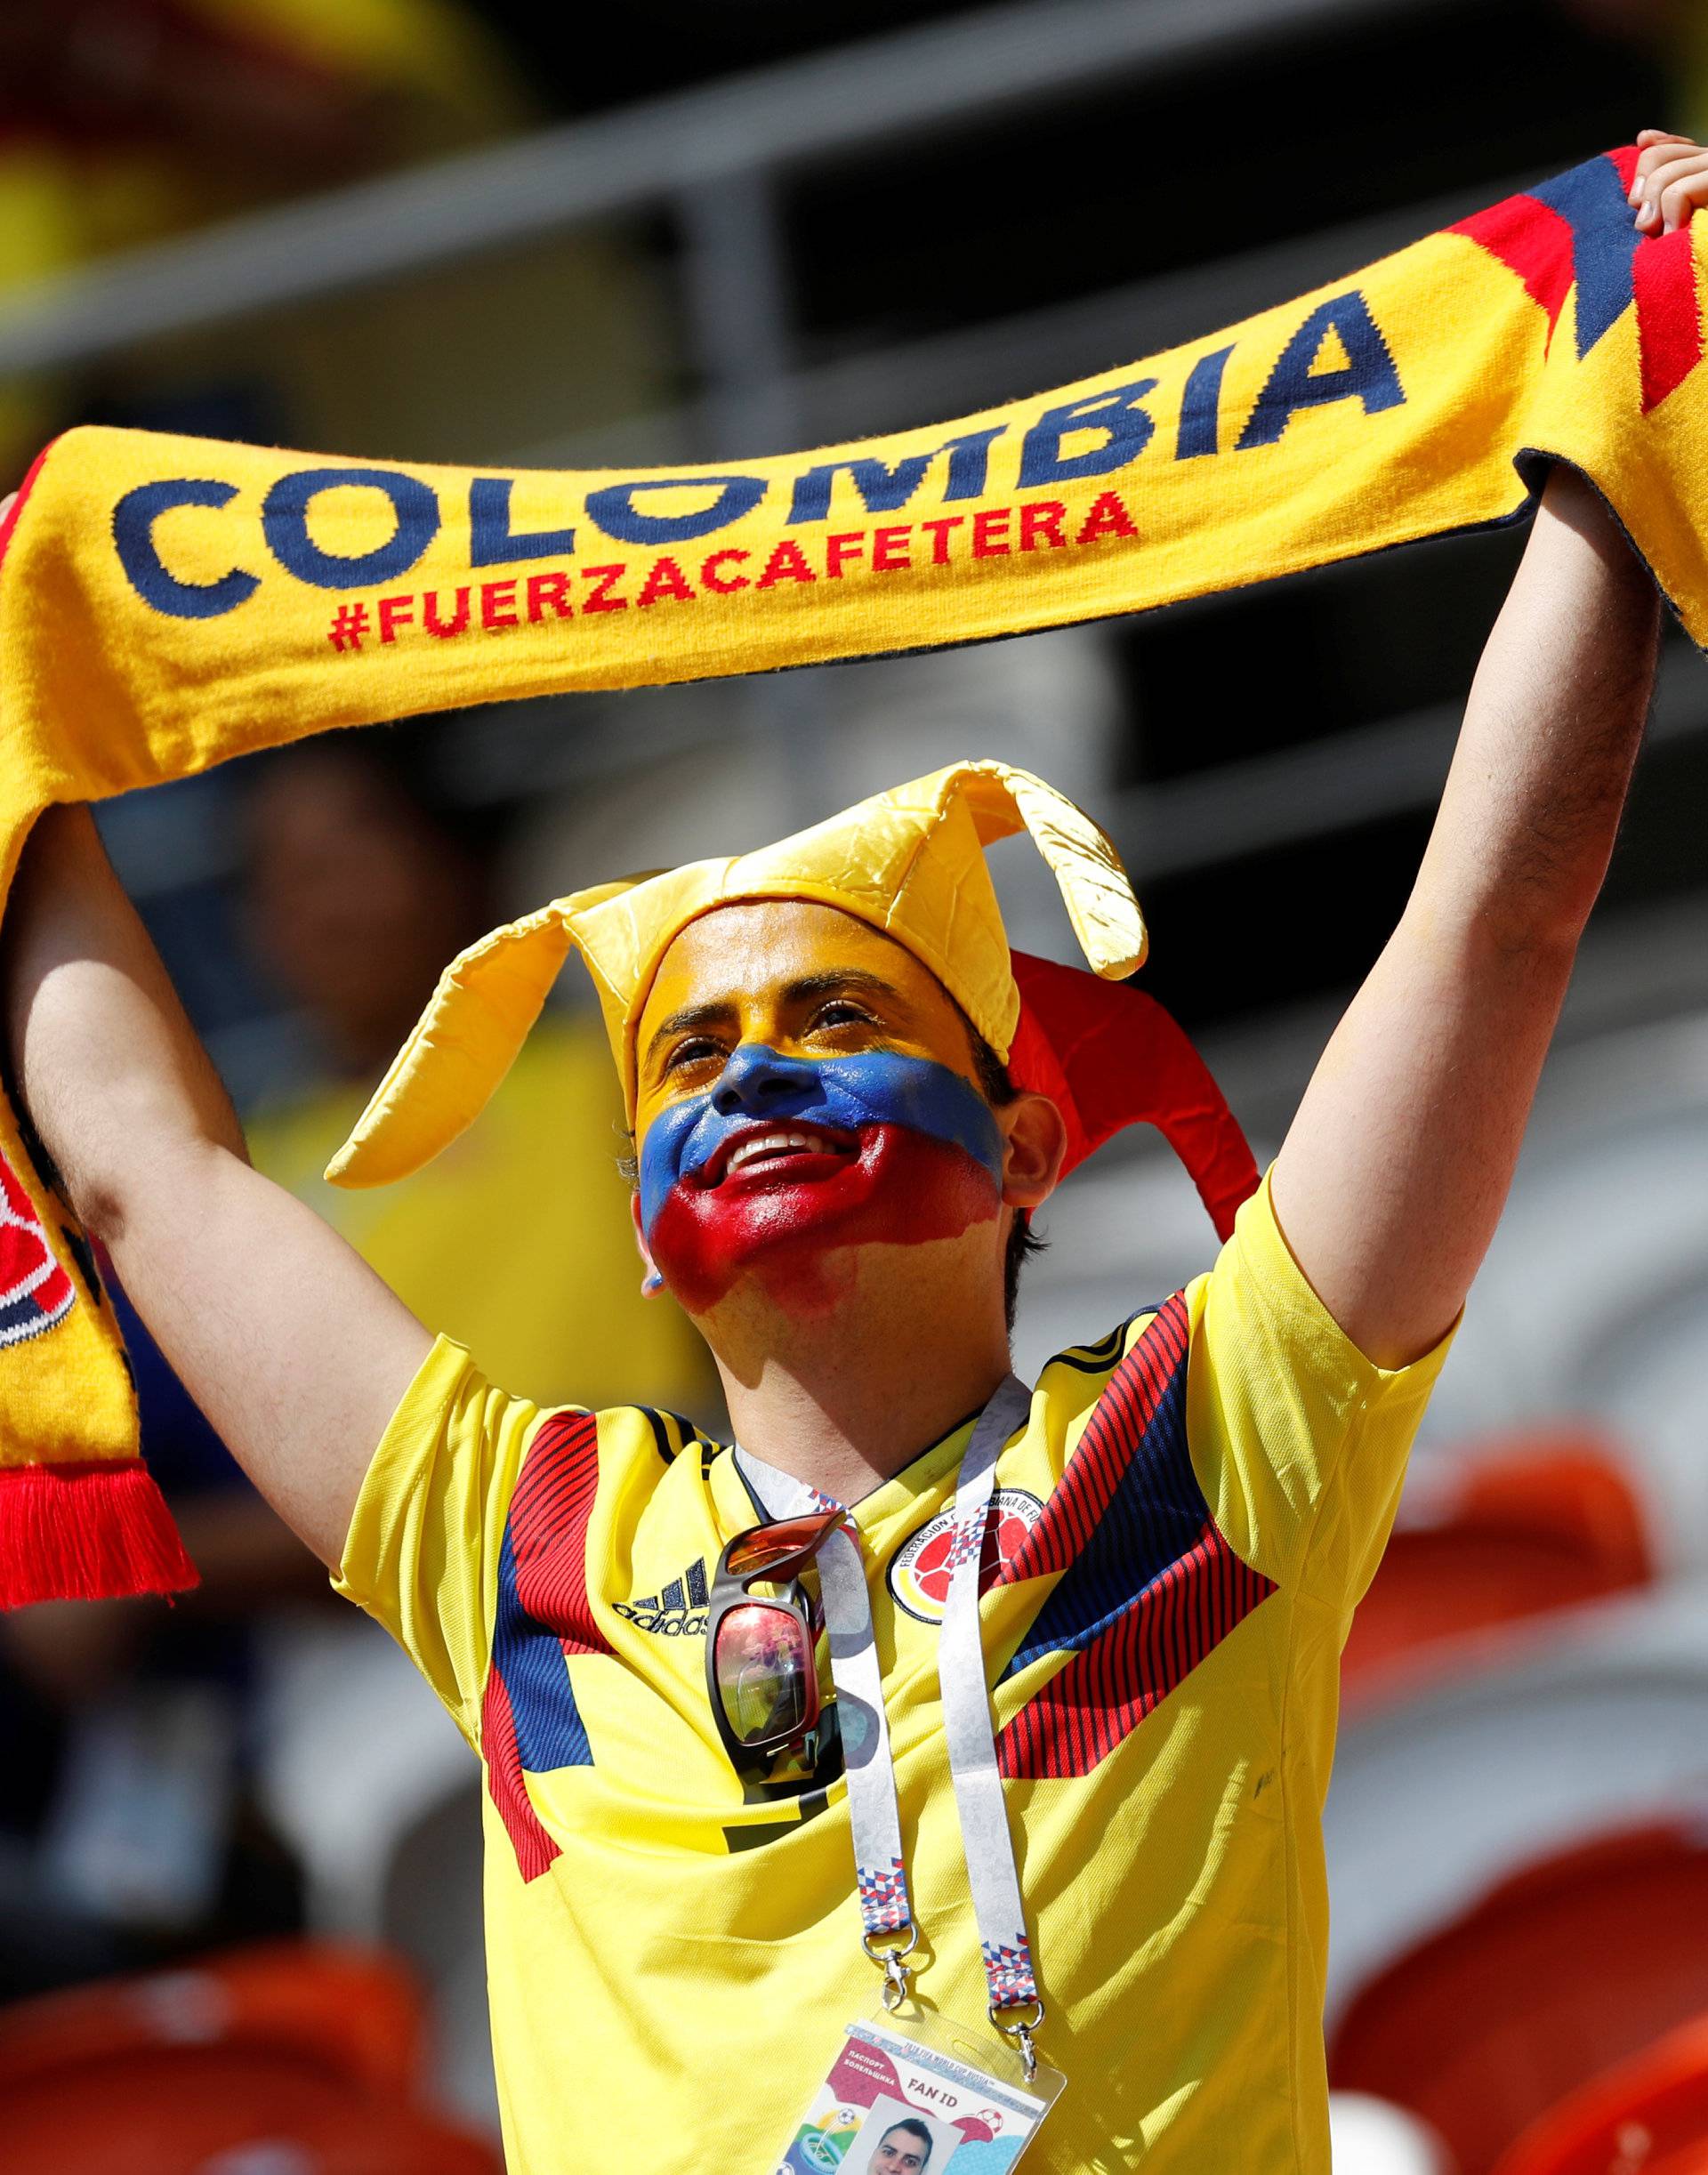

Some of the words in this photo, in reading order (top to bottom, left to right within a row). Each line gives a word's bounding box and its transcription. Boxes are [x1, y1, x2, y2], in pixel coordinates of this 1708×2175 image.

[111, 289, 1406, 620] COLOMBIA
[326, 490, 1139, 652] #FUERZACAFETERA
[899, 1518, 949, 1567] FEDERACION
[842, 2058, 896, 2086] БОЛЕЛЬЩИКА
[847, 2050, 886, 2070] ПАСПОРТ
[955, 2064, 969, 2075] CUP
[907, 2077, 939, 2099] FAN
[939, 2091, 959, 2108] ID
